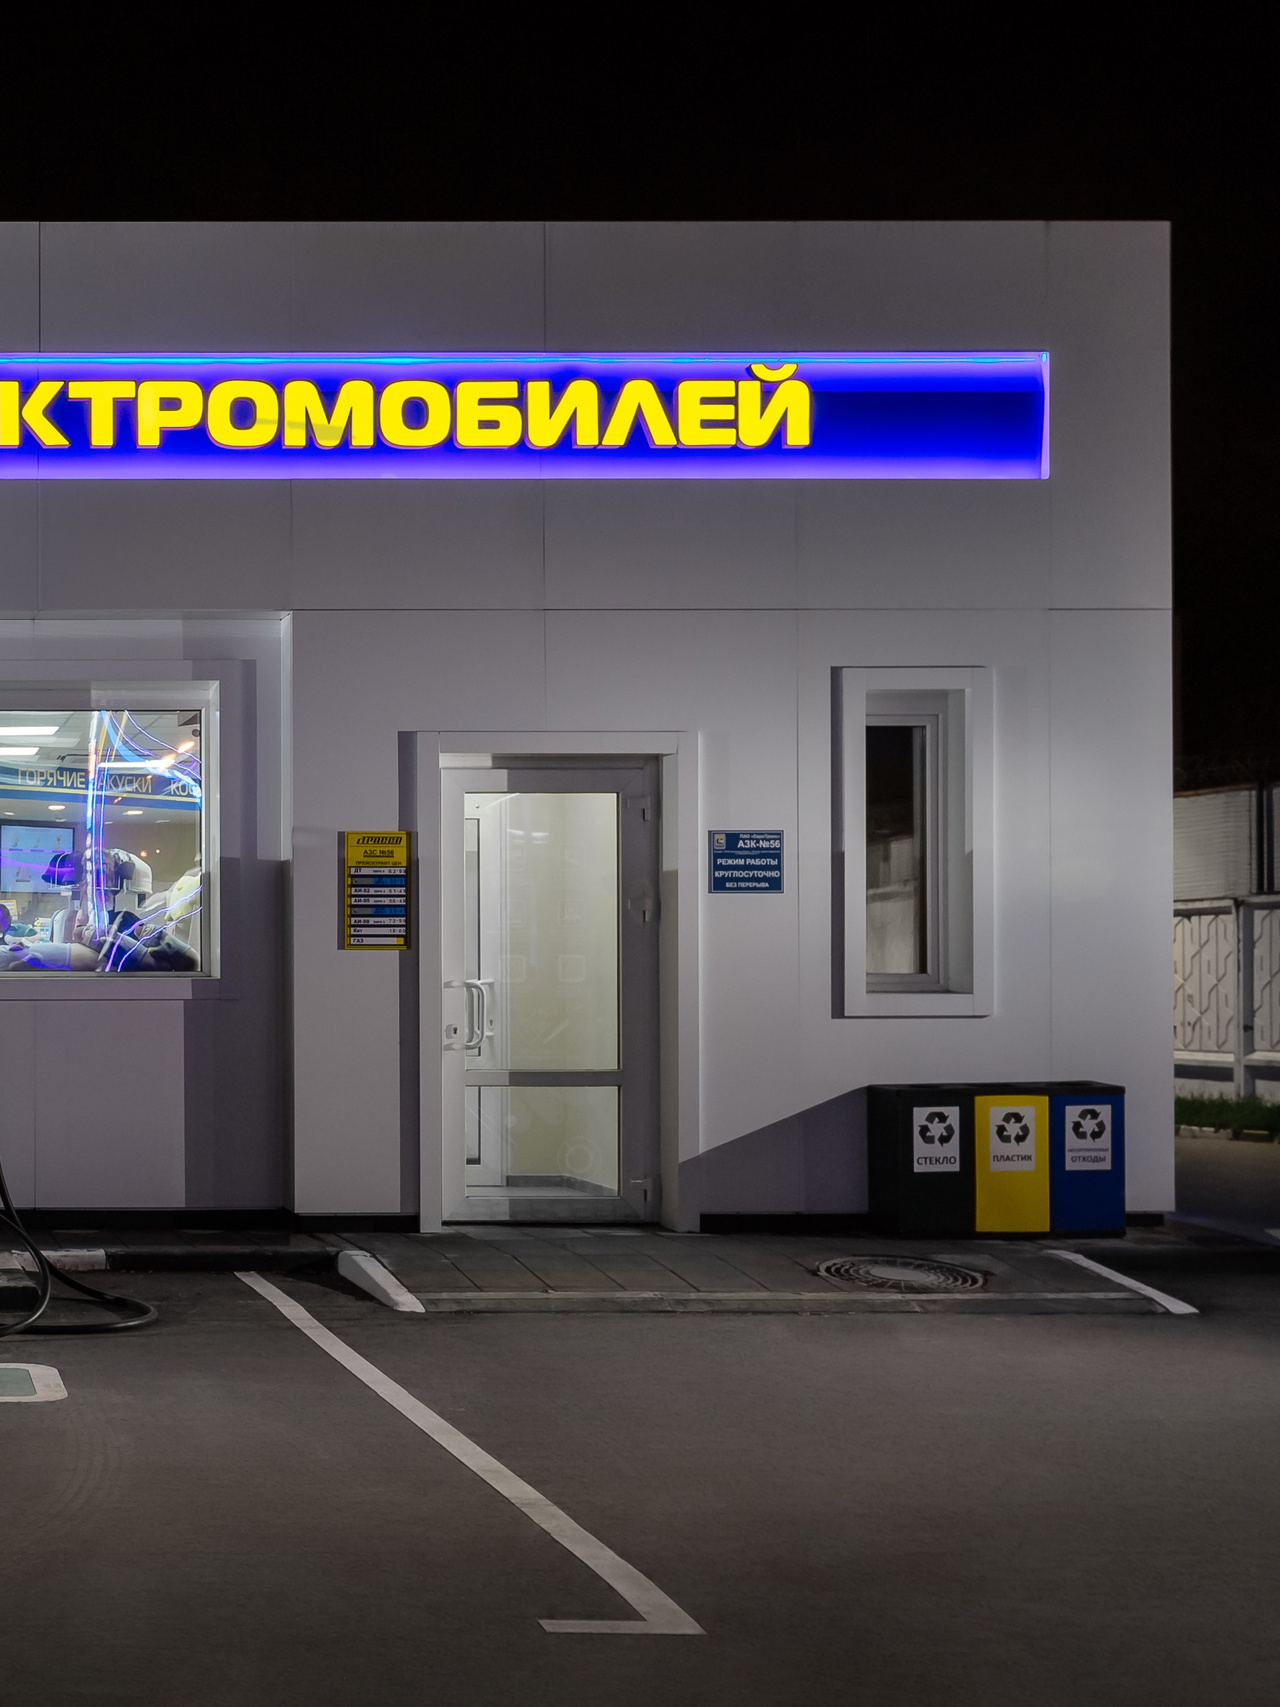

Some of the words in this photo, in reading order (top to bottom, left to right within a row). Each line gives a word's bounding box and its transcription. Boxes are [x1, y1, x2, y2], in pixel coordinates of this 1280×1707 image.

[18, 769, 86, 788] ГОРЯЧИЕ
[91, 771, 152, 794] АКУСКИ
[737, 840, 780, 848] АЗК-№56
[916, 1155, 957, 1166] СТЕКЛО
[993, 1154, 1033, 1163] ПЛАСТИК
[1071, 1155, 1106, 1163] ОТХОДЫ
